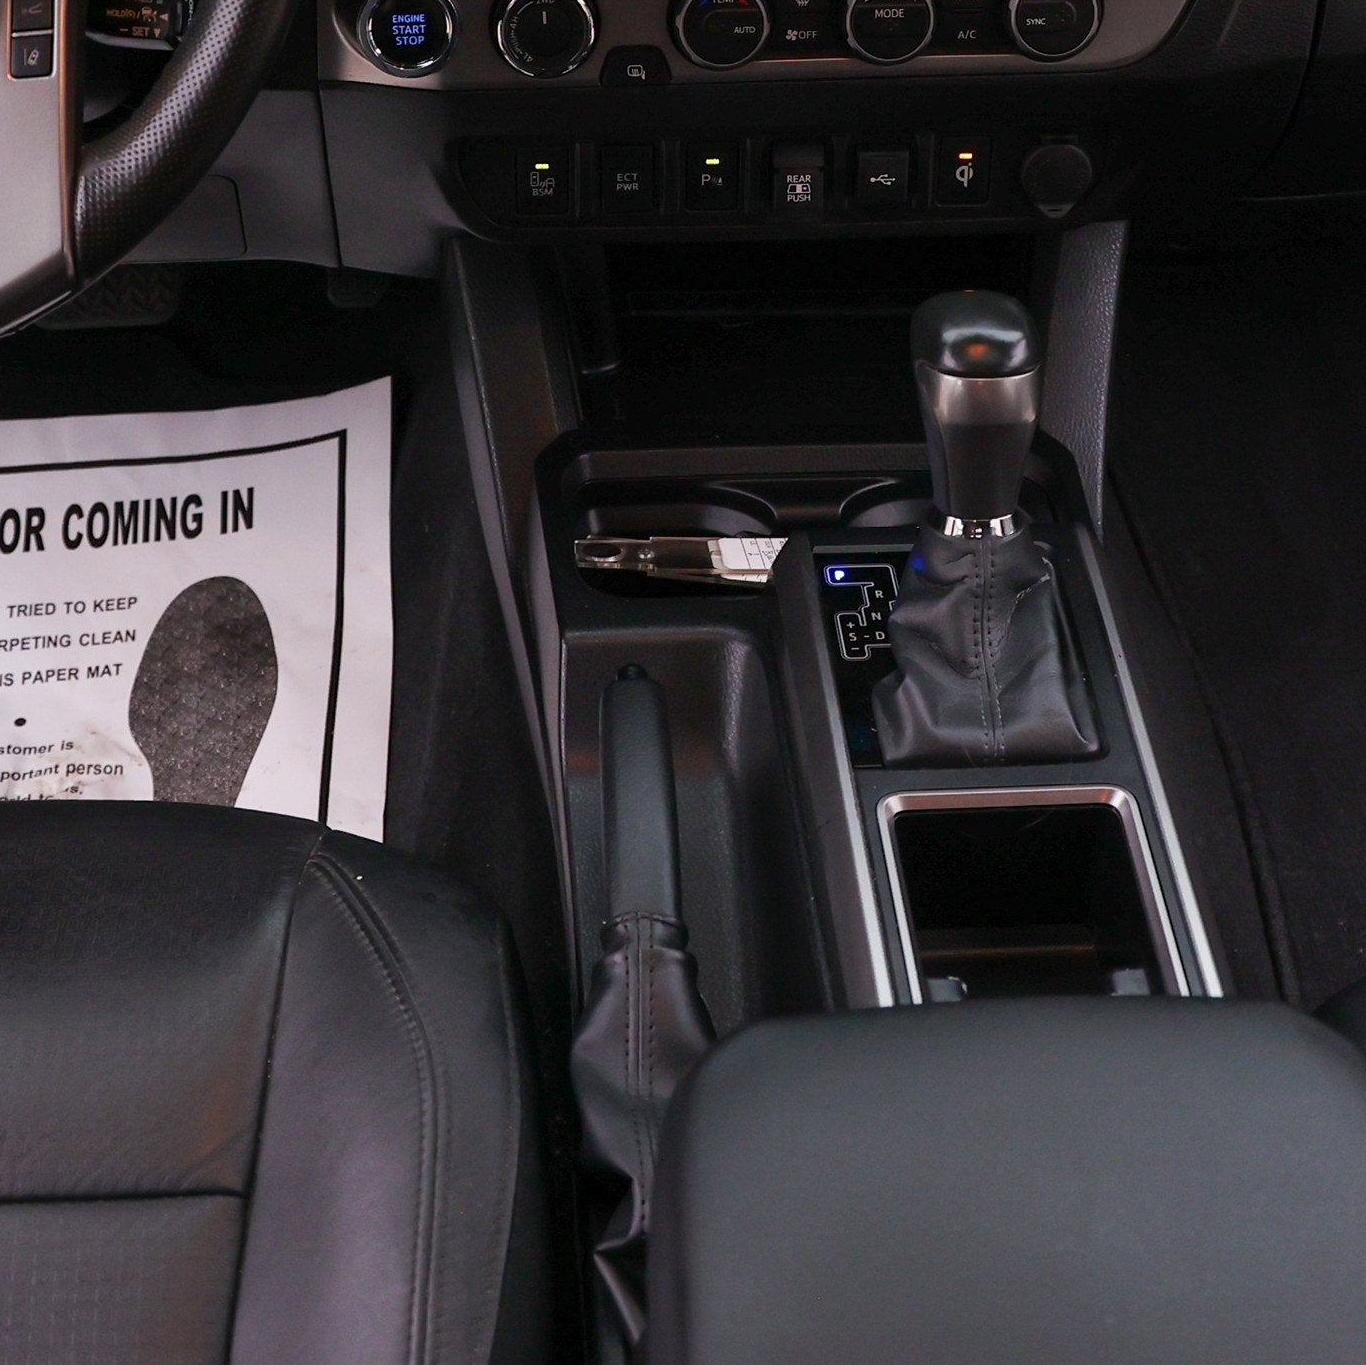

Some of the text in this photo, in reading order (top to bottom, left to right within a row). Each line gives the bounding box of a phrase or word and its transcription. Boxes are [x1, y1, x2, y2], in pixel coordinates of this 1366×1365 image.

[392, 14, 425, 23] ENGINE
[874, 8, 905, 19] MODE
[1025, 17, 1046, 26] SYNC
[132, 27, 150, 37] SET
[392, 24, 426, 35] START
[734, 26, 756, 34] AUTO
[957, 29, 977, 40] A/C
[798, 30, 818, 40] OFF
[395, 35, 425, 46] STOP
[616, 173, 638, 182] ECT
[701, 174, 711, 186] P
[786, 175, 812, 184] REAR
[532, 187, 553, 196] BSM
[616, 182, 639, 191] PWR
[787, 193, 812, 202] PUSH
[62, 494, 203, 550] COMING
[219, 486, 256, 535] IN
[875, 590, 884, 599] R
[7, 602, 56, 619] TRIED
[64, 601, 86, 615] TO
[93, 596, 138, 613] KEEP
[871, 612, 882, 621] N
[79, 629, 137, 647] CLEAN
[849, 632, 857, 642] S
[875, 631, 885, 640] D
[22, 667, 79, 685] PAPER
[87, 663, 123, 679] MAT
[60, 739, 74, 751] is
[66, 762, 124, 777] person
